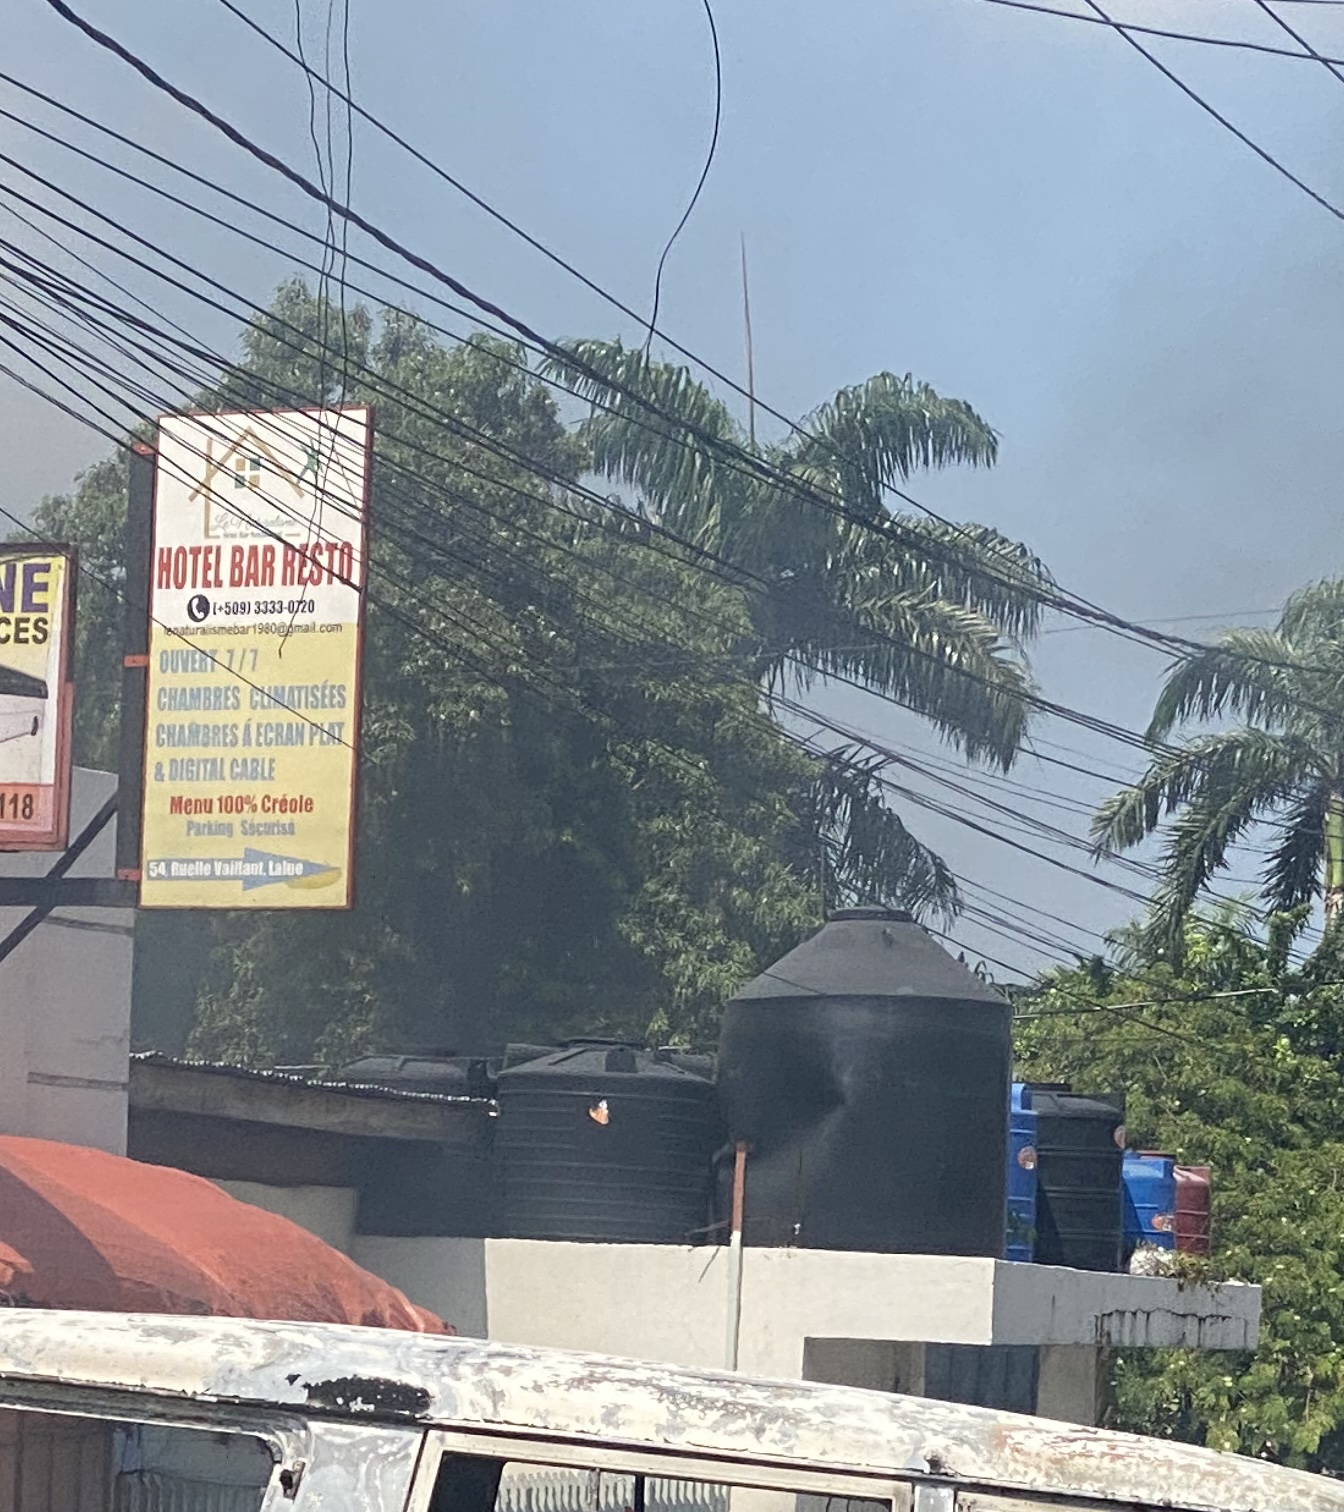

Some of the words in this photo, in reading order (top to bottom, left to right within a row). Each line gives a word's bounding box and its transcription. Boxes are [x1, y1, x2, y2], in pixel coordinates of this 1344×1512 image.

[157, 545, 223, 589] HOTEL
[229, 544, 276, 588] BAR
[281, 541, 354, 588] RESTO
[159, 649, 218, 674] OUVERT
[157, 685, 241, 711] CHAMBRES
[249, 680, 347, 711] CLIMATISÉES
[155, 722, 239, 748] CHAMBRES
[256, 721, 305, 747] ECRAN
[308, 721, 345, 746] PLAT
[154, 761, 165, 782] &
[168, 757, 226, 782] DIGITAL
[230, 757, 276, 781] CABLE
[169, 795, 213, 815] Menu
[217, 794, 257, 815] 100%
[260, 793, 315, 814] Créole
[186, 819, 234, 838] Parking
[170, 860, 212, 877] Ruelle
[268, 860, 304, 876] Lalue
